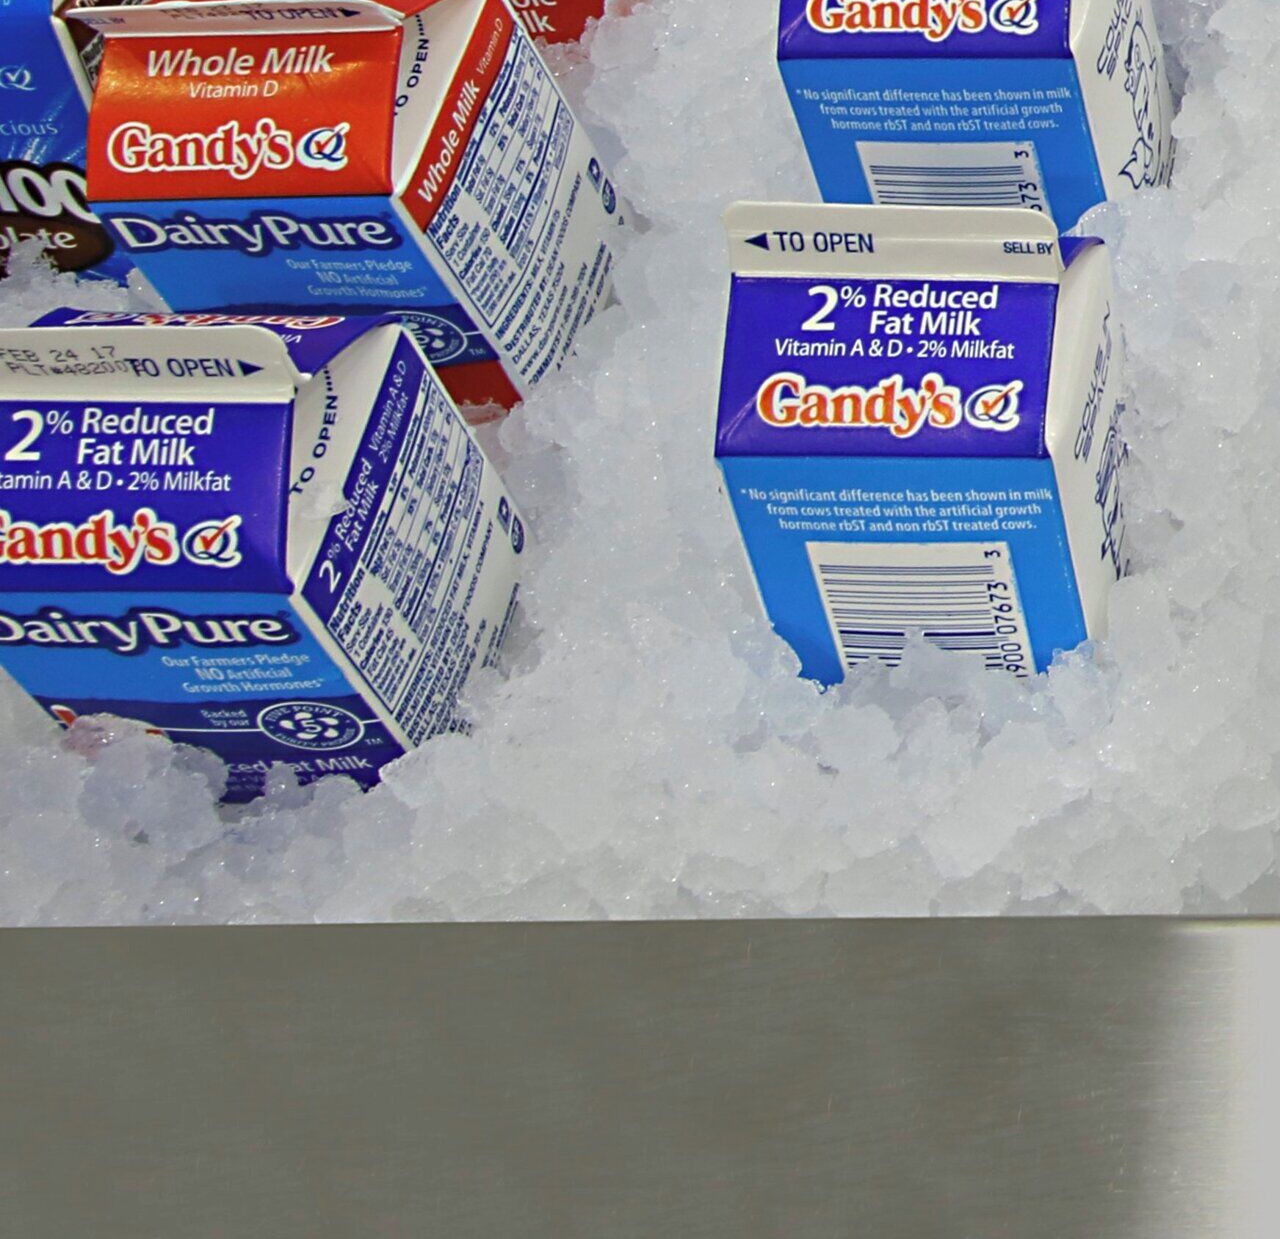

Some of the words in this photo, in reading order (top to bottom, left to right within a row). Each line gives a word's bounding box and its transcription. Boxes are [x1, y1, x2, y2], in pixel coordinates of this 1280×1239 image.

[147, 47, 255, 76] Whole
[261, 45, 334, 74] Milk
[108, 118, 294, 180] Gandy's
[417, 131, 460, 203] Whole
[453, 78, 480, 130] Milk
[111, 215, 393, 252] DairyPure
[773, 232, 805, 252] TO
[814, 232, 874, 254] OPEN
[1003, 241, 1034, 255] SELL
[1038, 243, 1054, 255] BY
[802, 285, 866, 331] 2%
[874, 284, 999, 309] Reduced
[870, 311, 914, 334] Fat
[920, 311, 981, 336] Milk
[124, 359, 159, 378] TO
[168, 359, 234, 378] OPEN
[757, 372, 963, 438] Gandy's
[5, 410, 74, 460] 2%
[81, 408, 216, 435] Reduced
[313, 395, 338, 460] OPEN
[76, 438, 124, 466] Fat
[130, 440, 196, 466] Milk
[766, 503, 798, 516] from
[801, 505, 831, 516] cows
[833, 504, 880, 516] treated
[884, 504, 912, 516] with
[915, 504, 936, 516] the
[780, 518, 836, 530] hormone
[869, 520, 892, 531] and
[195, 667, 224, 680] NO
[228, 667, 292, 679] Artificial
